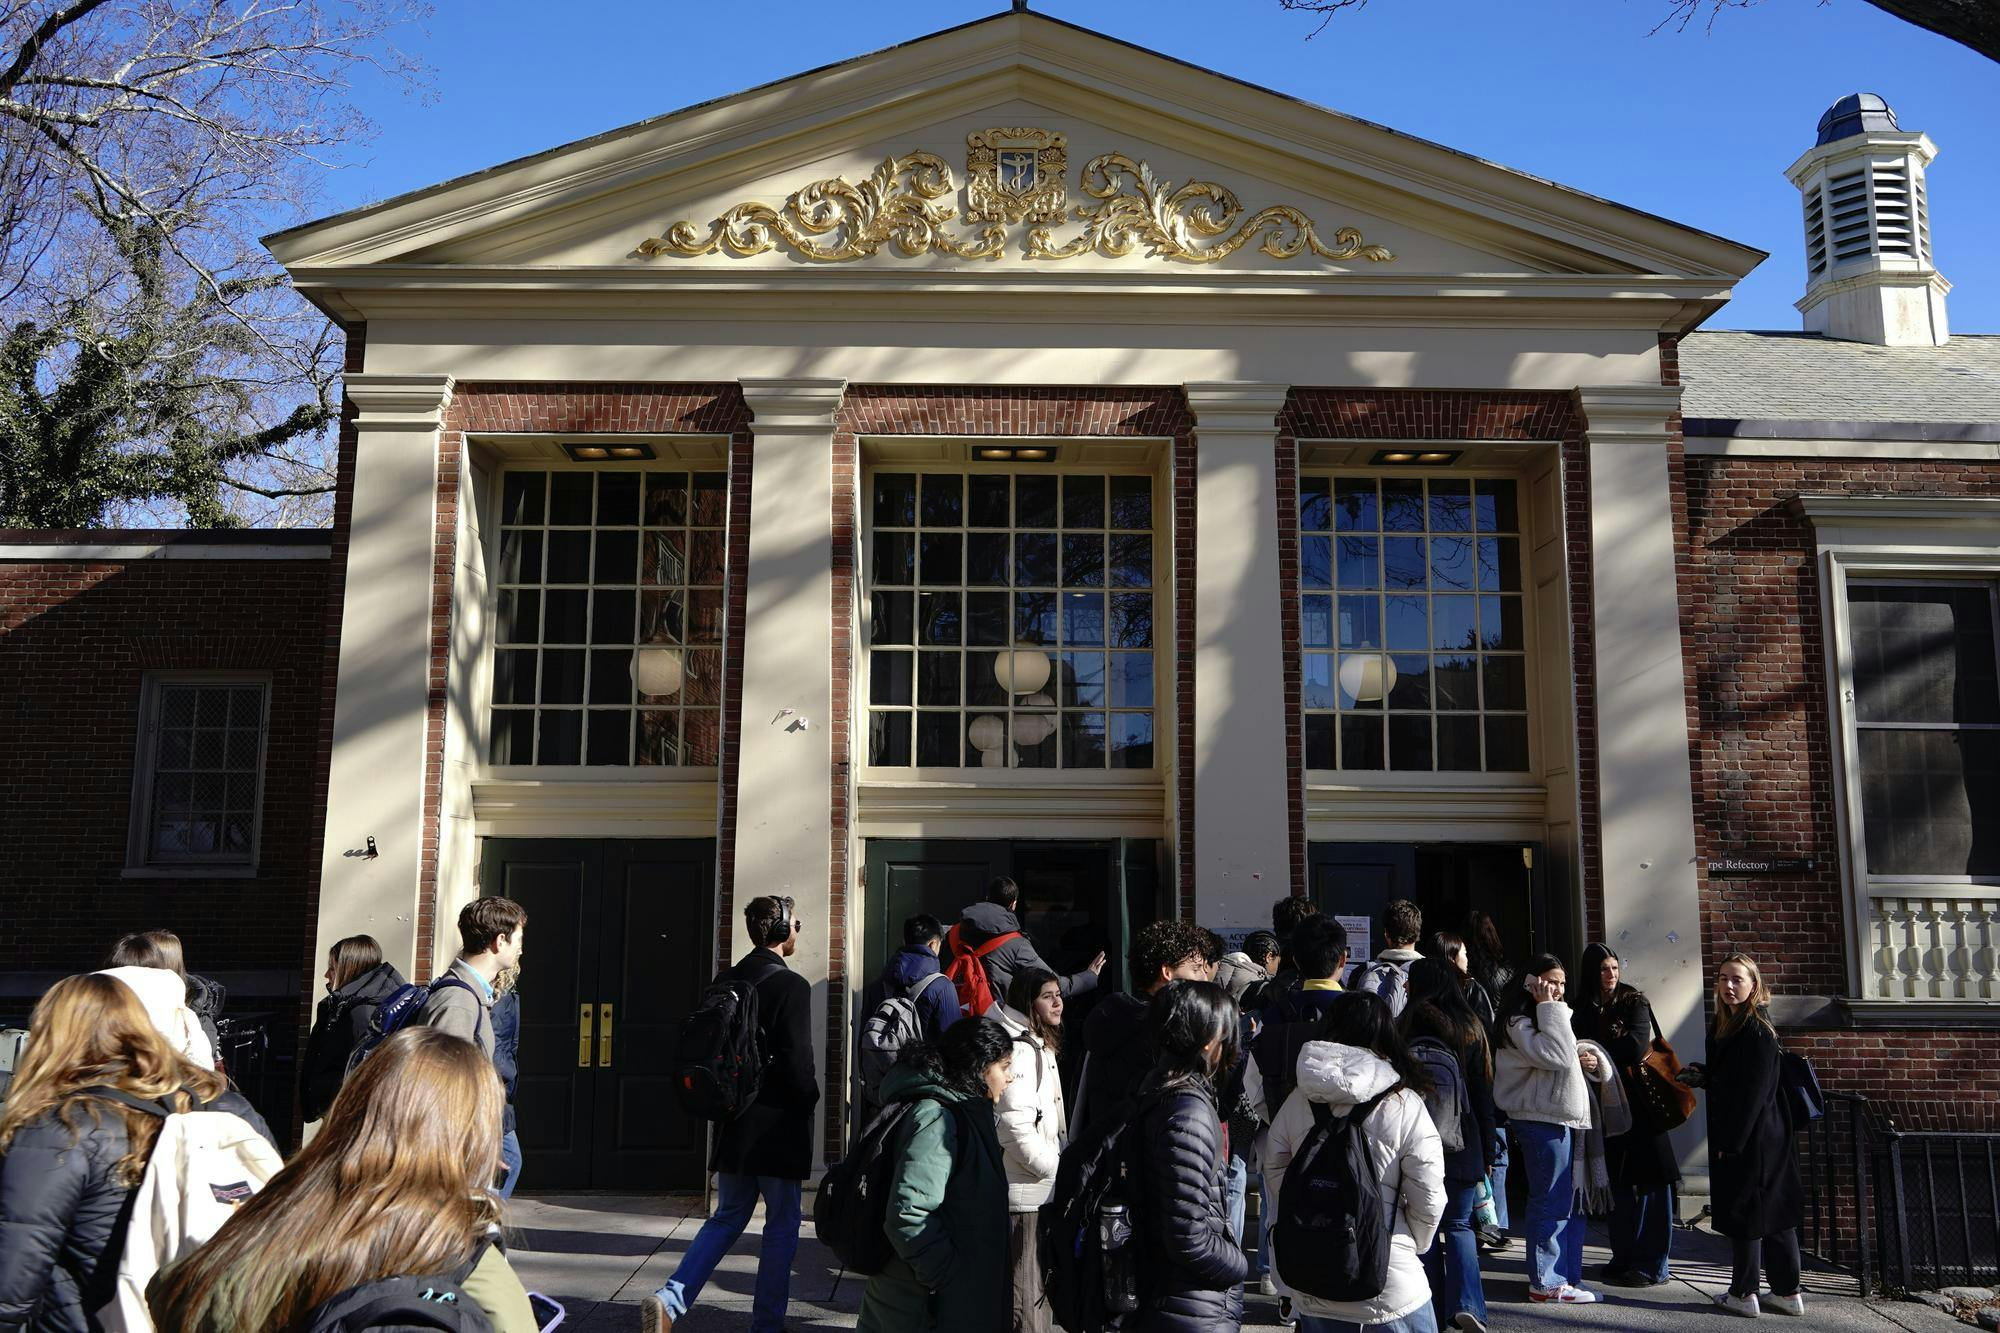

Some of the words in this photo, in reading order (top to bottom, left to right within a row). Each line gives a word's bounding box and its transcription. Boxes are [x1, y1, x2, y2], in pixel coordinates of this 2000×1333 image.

[1708, 861, 1723, 871] rpe
[1726, 860, 1769, 871] Refectory
[1229, 933, 1248, 941] ACC
